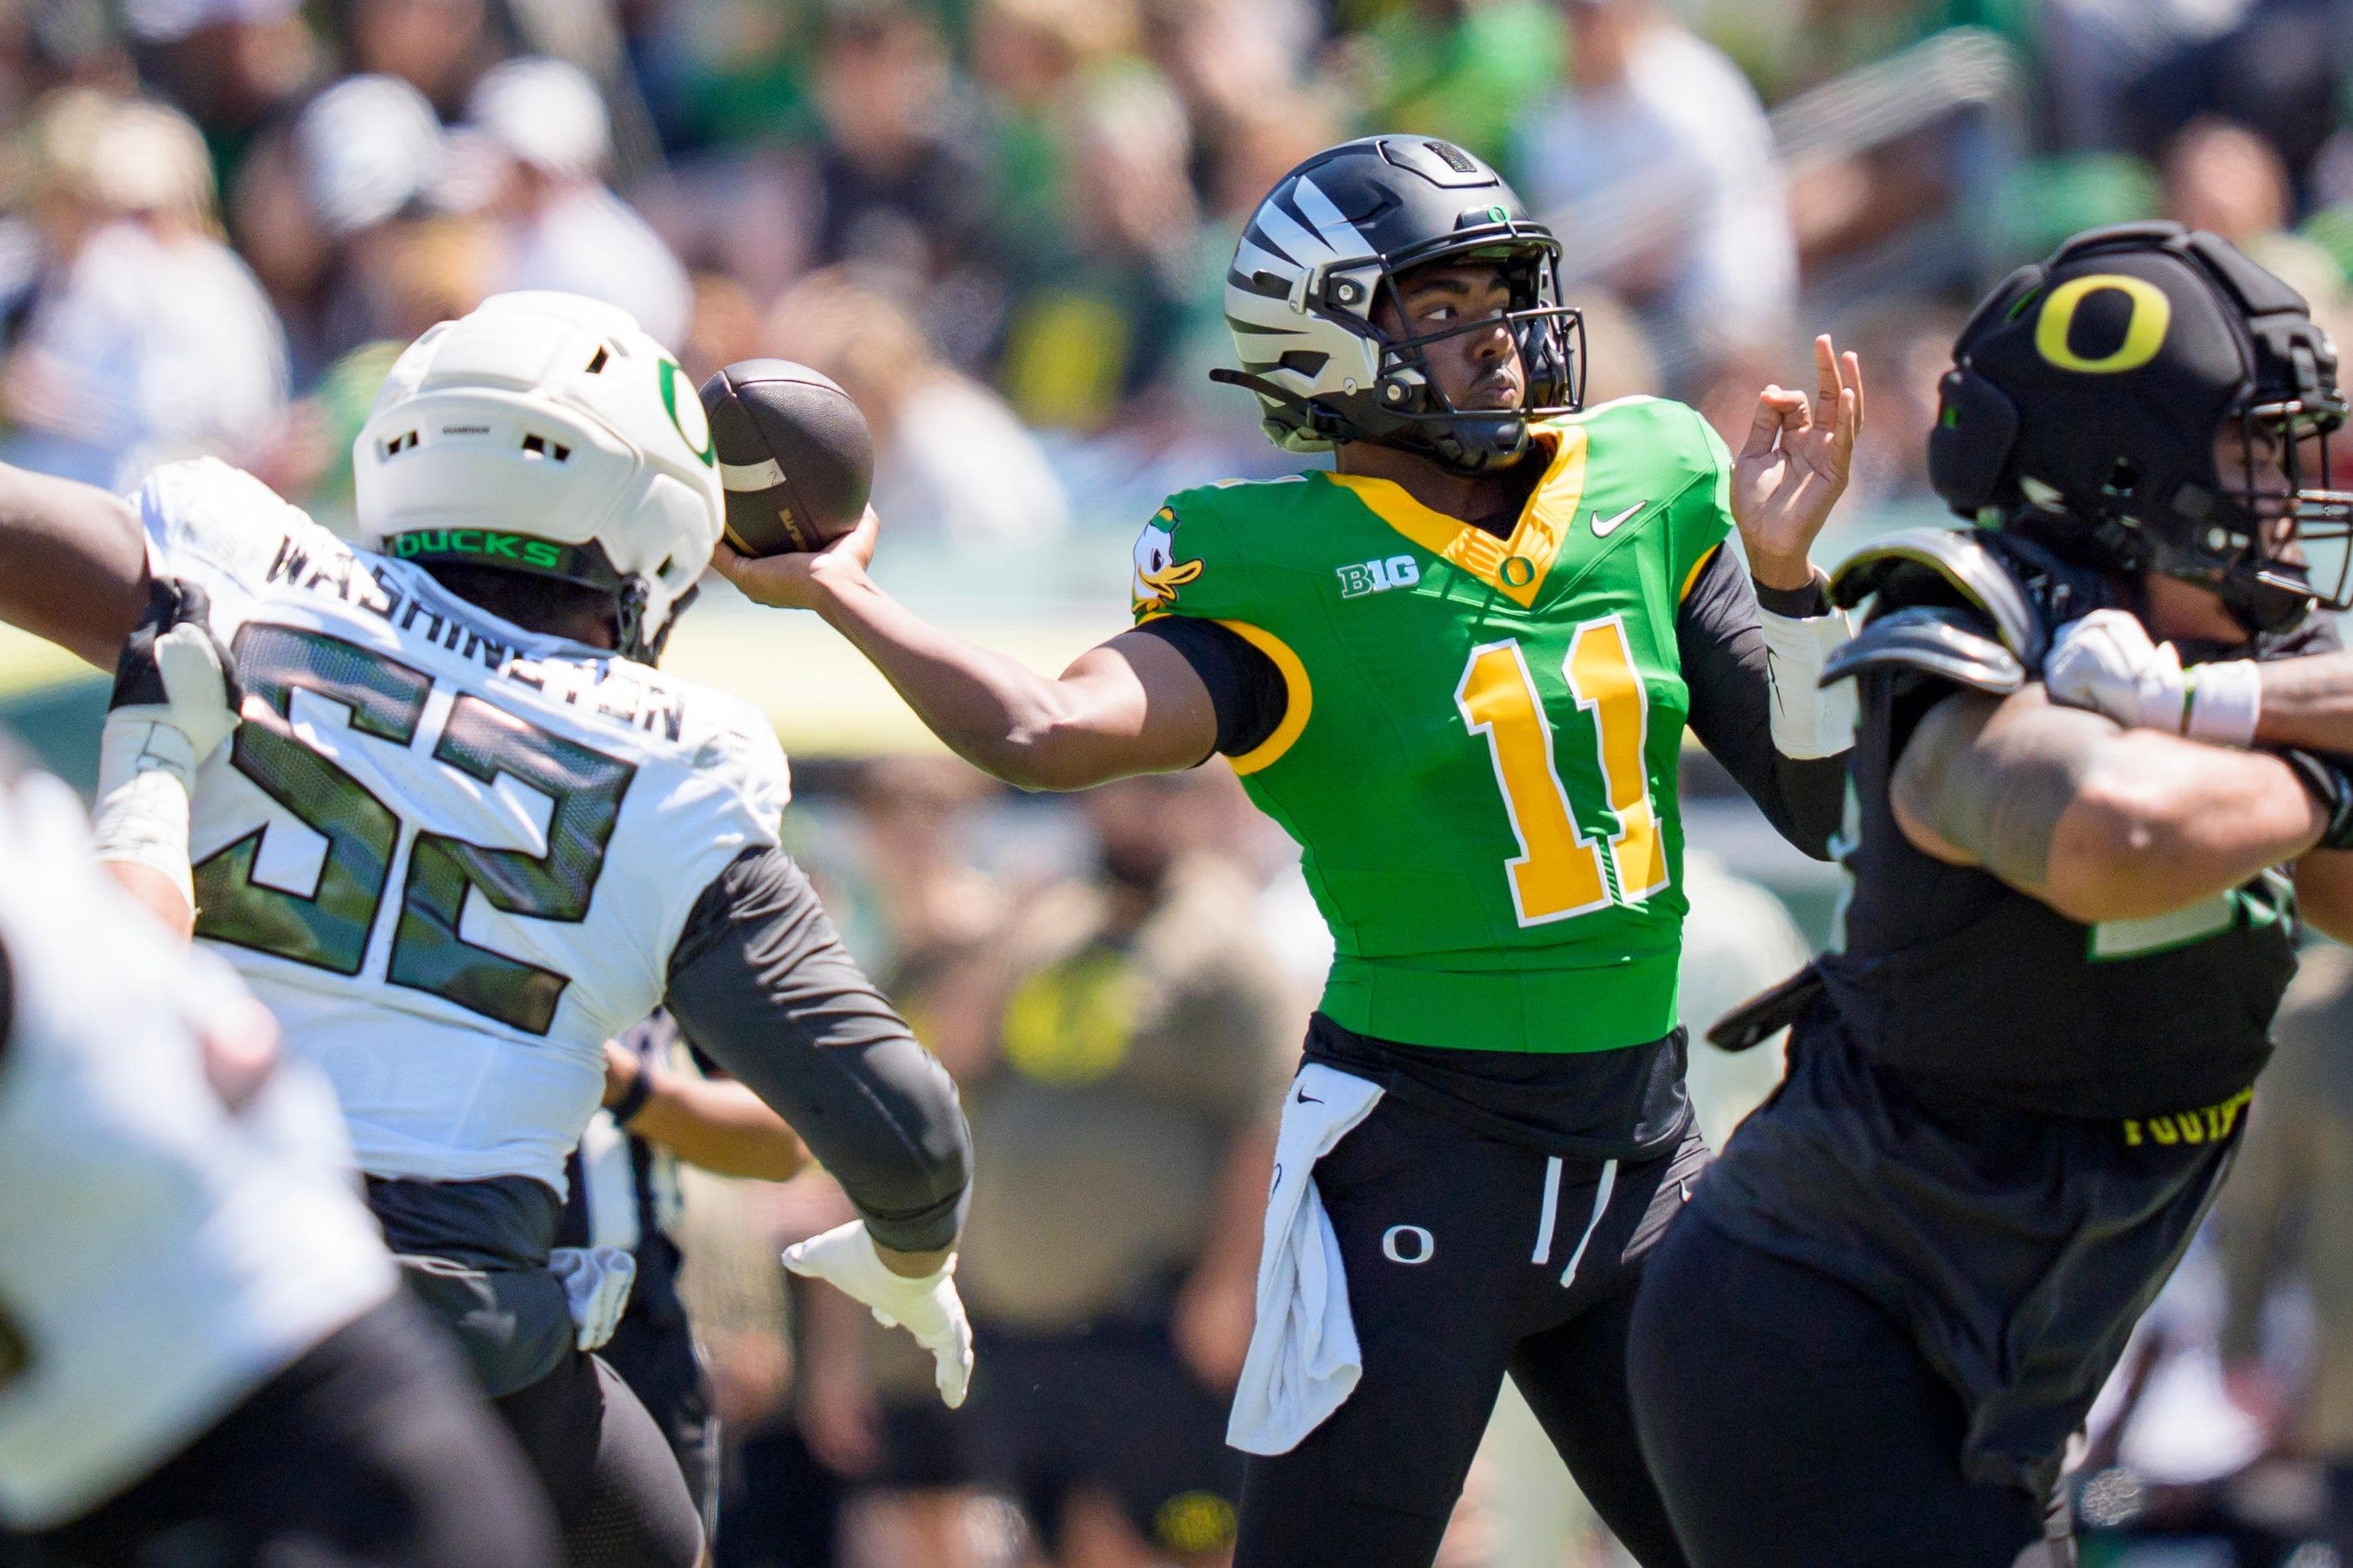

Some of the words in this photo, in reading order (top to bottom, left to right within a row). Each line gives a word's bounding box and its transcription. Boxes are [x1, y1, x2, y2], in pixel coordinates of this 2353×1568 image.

[2036, 274, 2170, 373] O
[397, 528, 560, 568] DUCKS
[1453, 614, 1671, 928] 11
[193, 621, 639, 1037] 52
[1382, 1225, 1435, 1264] O
